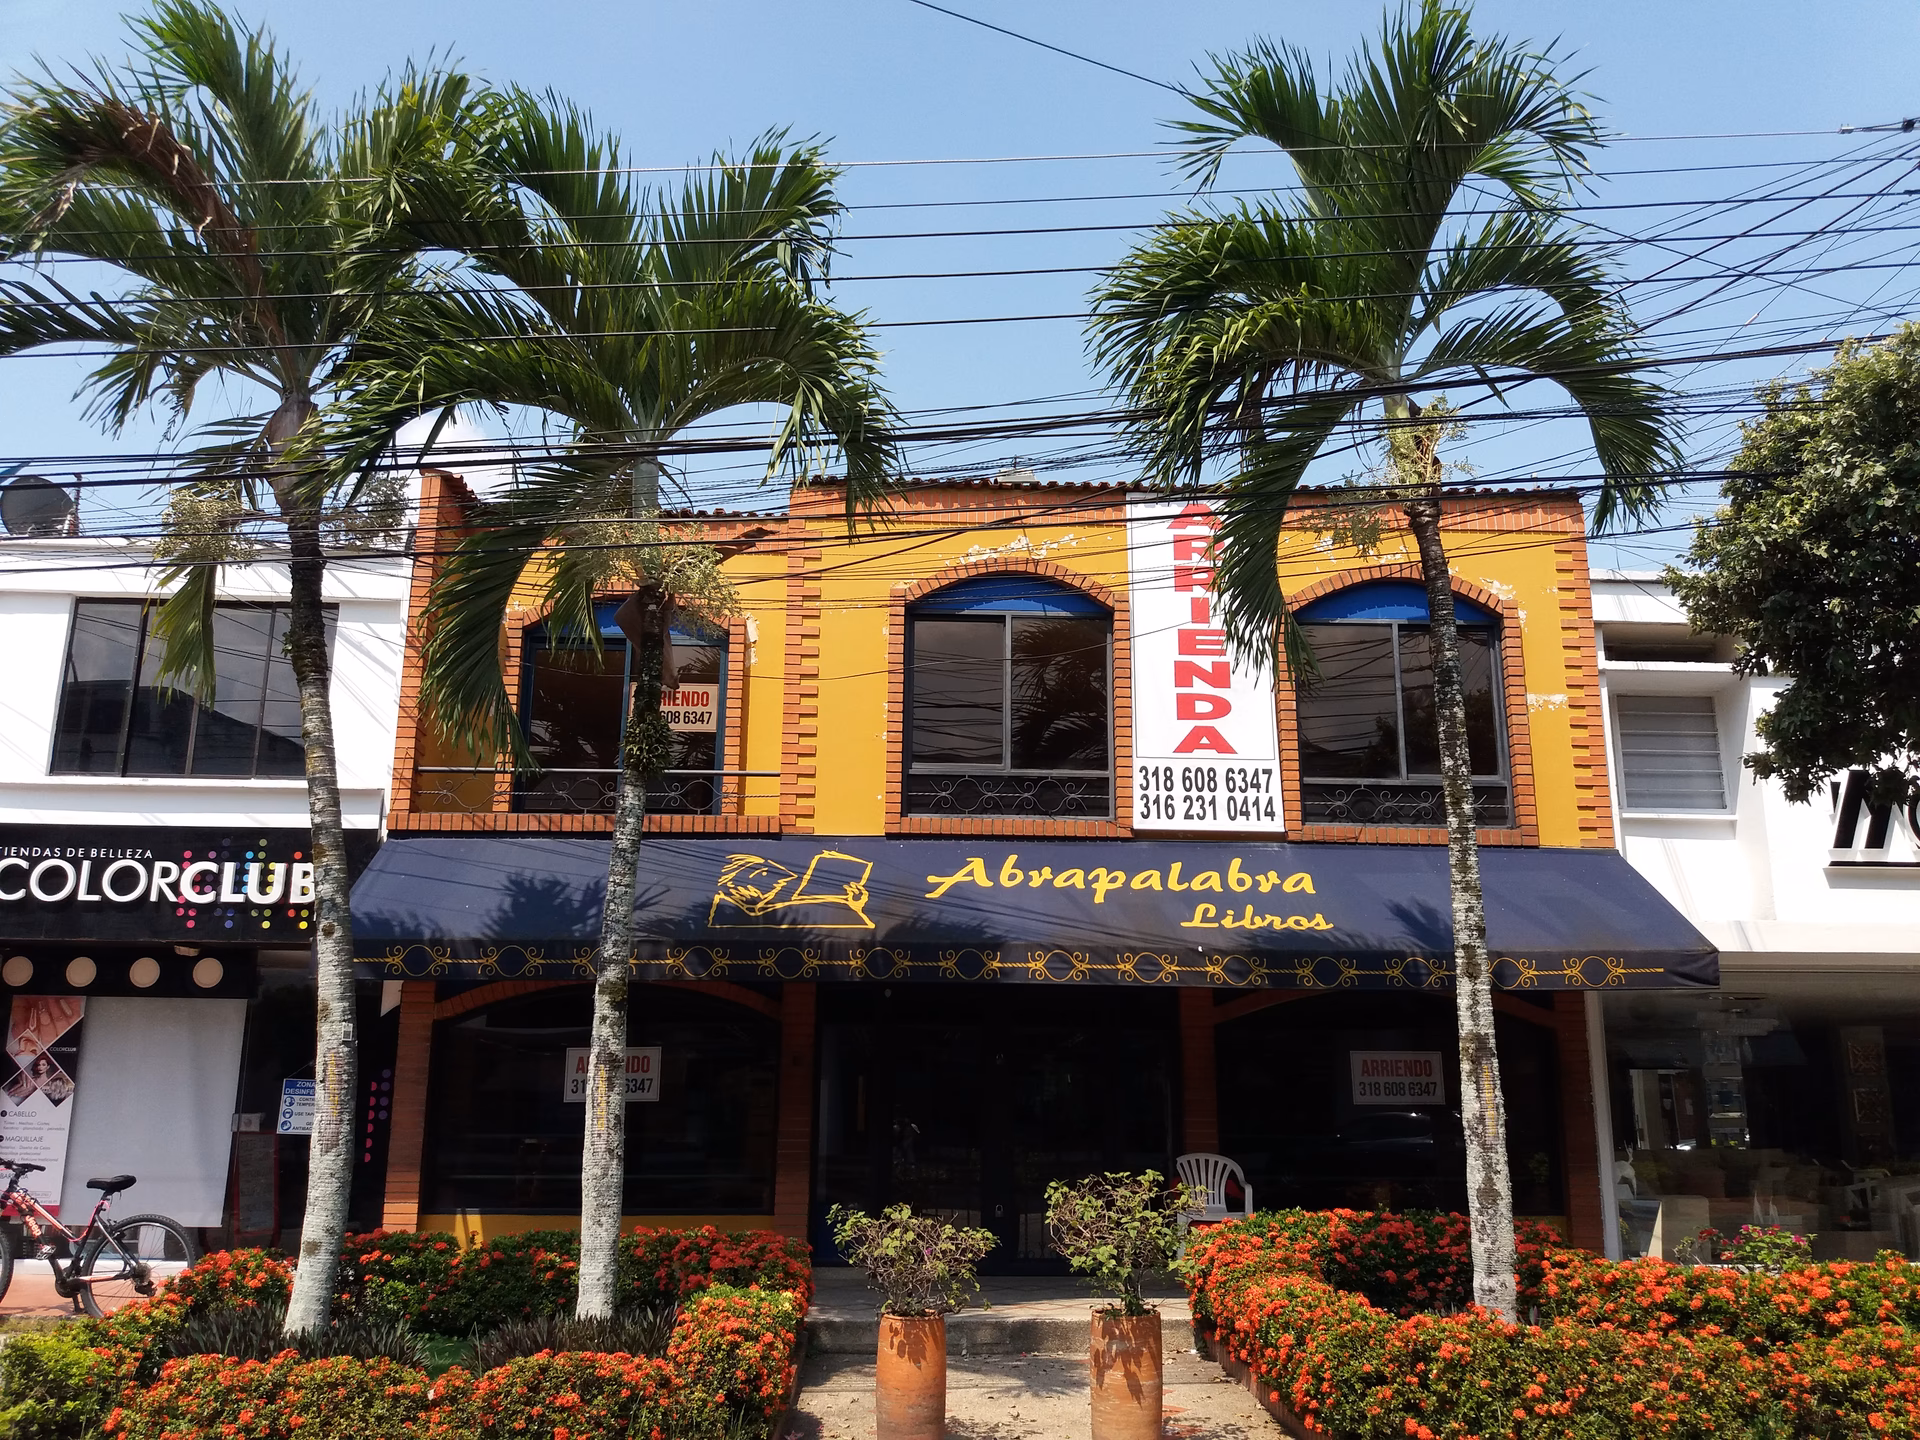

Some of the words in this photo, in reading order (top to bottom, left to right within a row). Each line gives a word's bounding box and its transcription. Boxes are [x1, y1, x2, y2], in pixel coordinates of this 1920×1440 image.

[1166, 503, 1239, 755] ARRIENDA
[683, 711, 712, 724] 6347
[1139, 766, 1174, 792] 318
[1182, 767, 1217, 793] 608
[1225, 768, 1273, 794] 6347
[1139, 794, 1175, 820] 316
[1183, 795, 1217, 820] 231
[1227, 795, 1276, 821] 0414
[66, 848, 86, 857] DE
[90, 848, 153, 859] BELLEZA
[925, 854, 1316, 903] Abrapalabra
[1180, 903, 1334, 930] Libros
[1361, 1059, 1433, 1077] ARRIENDO
[571, 1078, 587, 1094] 31
[1359, 1081, 1381, 1097] 318
[1384, 1081, 1406, 1096] 608
[1408, 1081, 1437, 1096] 6347
[8, 1110, 37, 1118] CABELLO
[5, 1135, 44, 1143] MAQUILLAJE
[25, 1215, 42, 1237] Jeep
